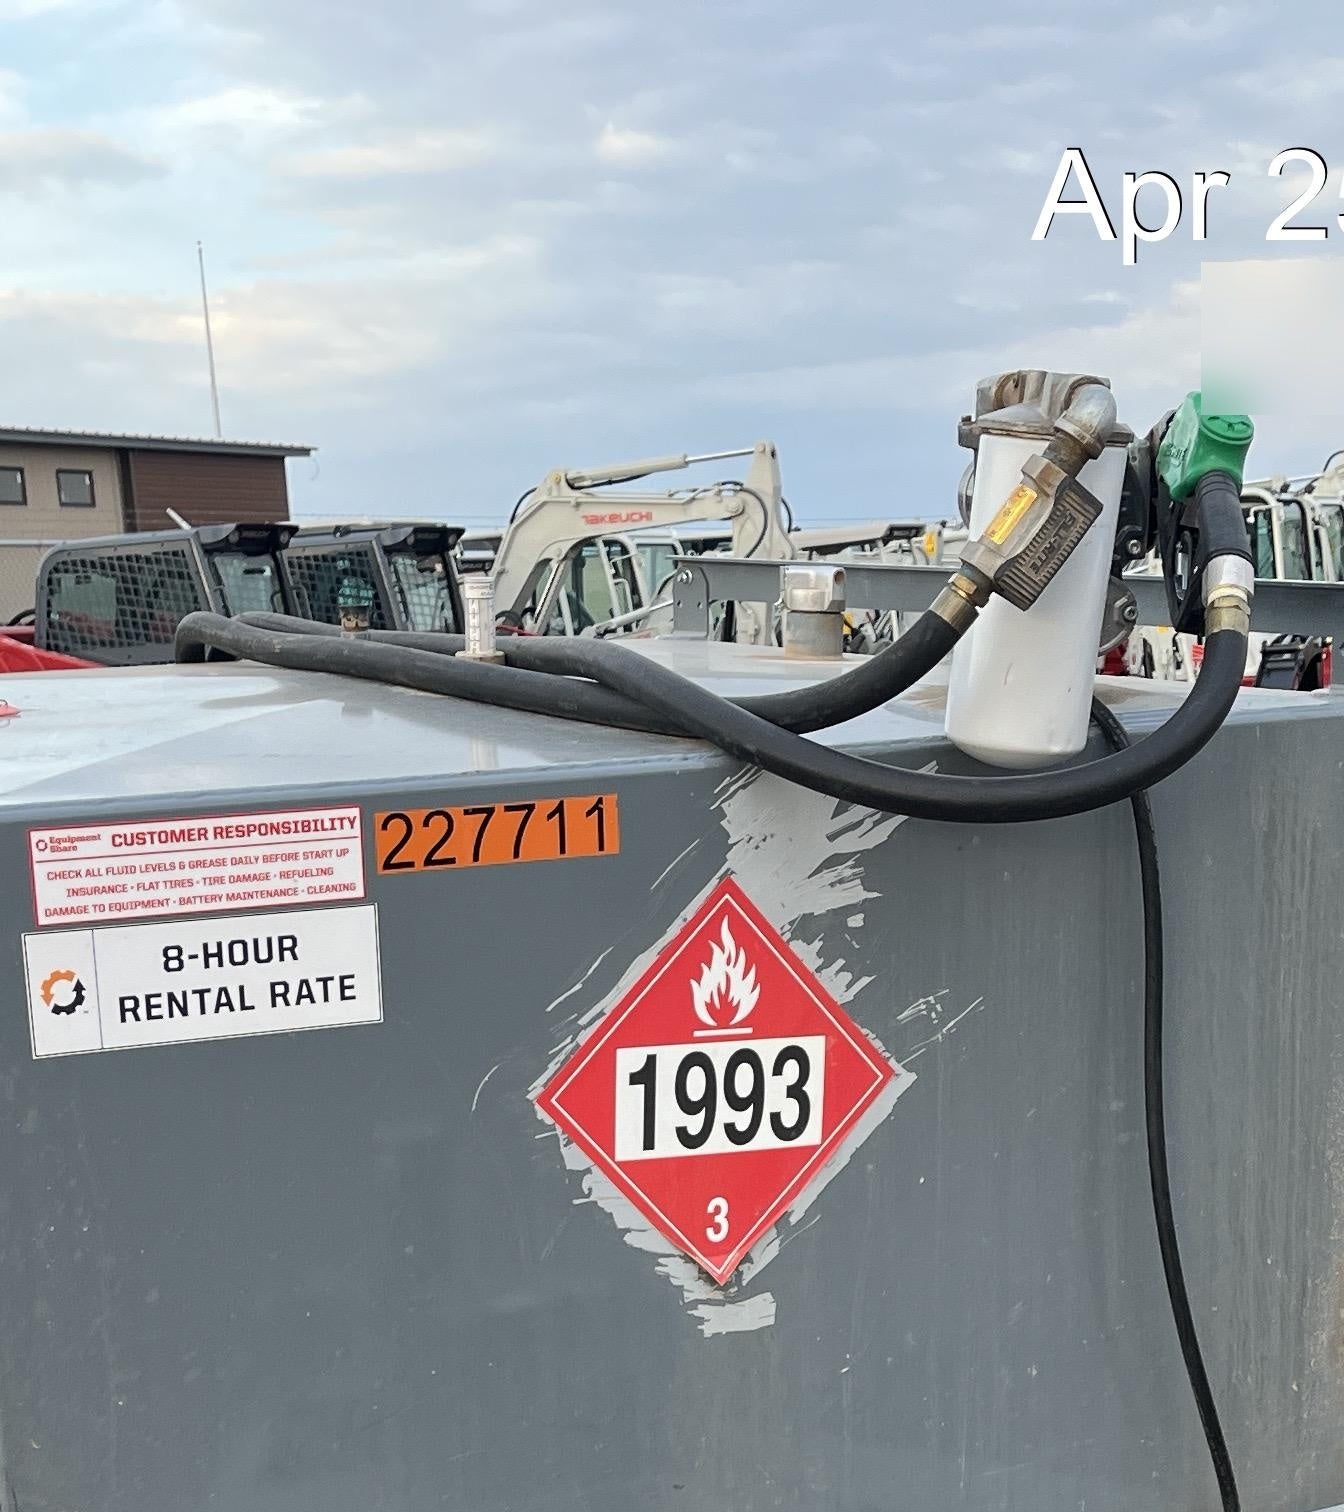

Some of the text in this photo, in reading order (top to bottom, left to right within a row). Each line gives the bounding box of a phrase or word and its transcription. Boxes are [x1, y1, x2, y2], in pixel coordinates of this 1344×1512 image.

[49, 832, 102, 846] Equipment
[110, 815, 357, 848] CUSTOMER RESPONSIBILITY
[380, 796, 607, 872] 227711
[47, 869, 83, 881] CHECK
[85, 867, 104, 878] ALL
[106, 864, 137, 876] FLUID
[139, 861, 177, 874] LEVELS
[188, 857, 228, 870] GREASE
[230, 855, 260, 867] DAILY
[262, 852, 300, 864] BEFORE
[302, 849, 334, 861] START
[336, 848, 350, 858] UP
[66, 866, 335, 898] INSURANCE FLAT TIRES TIRE DAMAGE REFUELING
[44, 882, 357, 918] DAMAGE TO EQUIPMENT BATTERY MAINTENANCE CLEANING
[161, 933, 300, 974] 8-HOUR
[118, 973, 357, 1025] RENTAL RATE
[629, 1044, 812, 1152] 1993
[706, 1196, 730, 1243] 3
